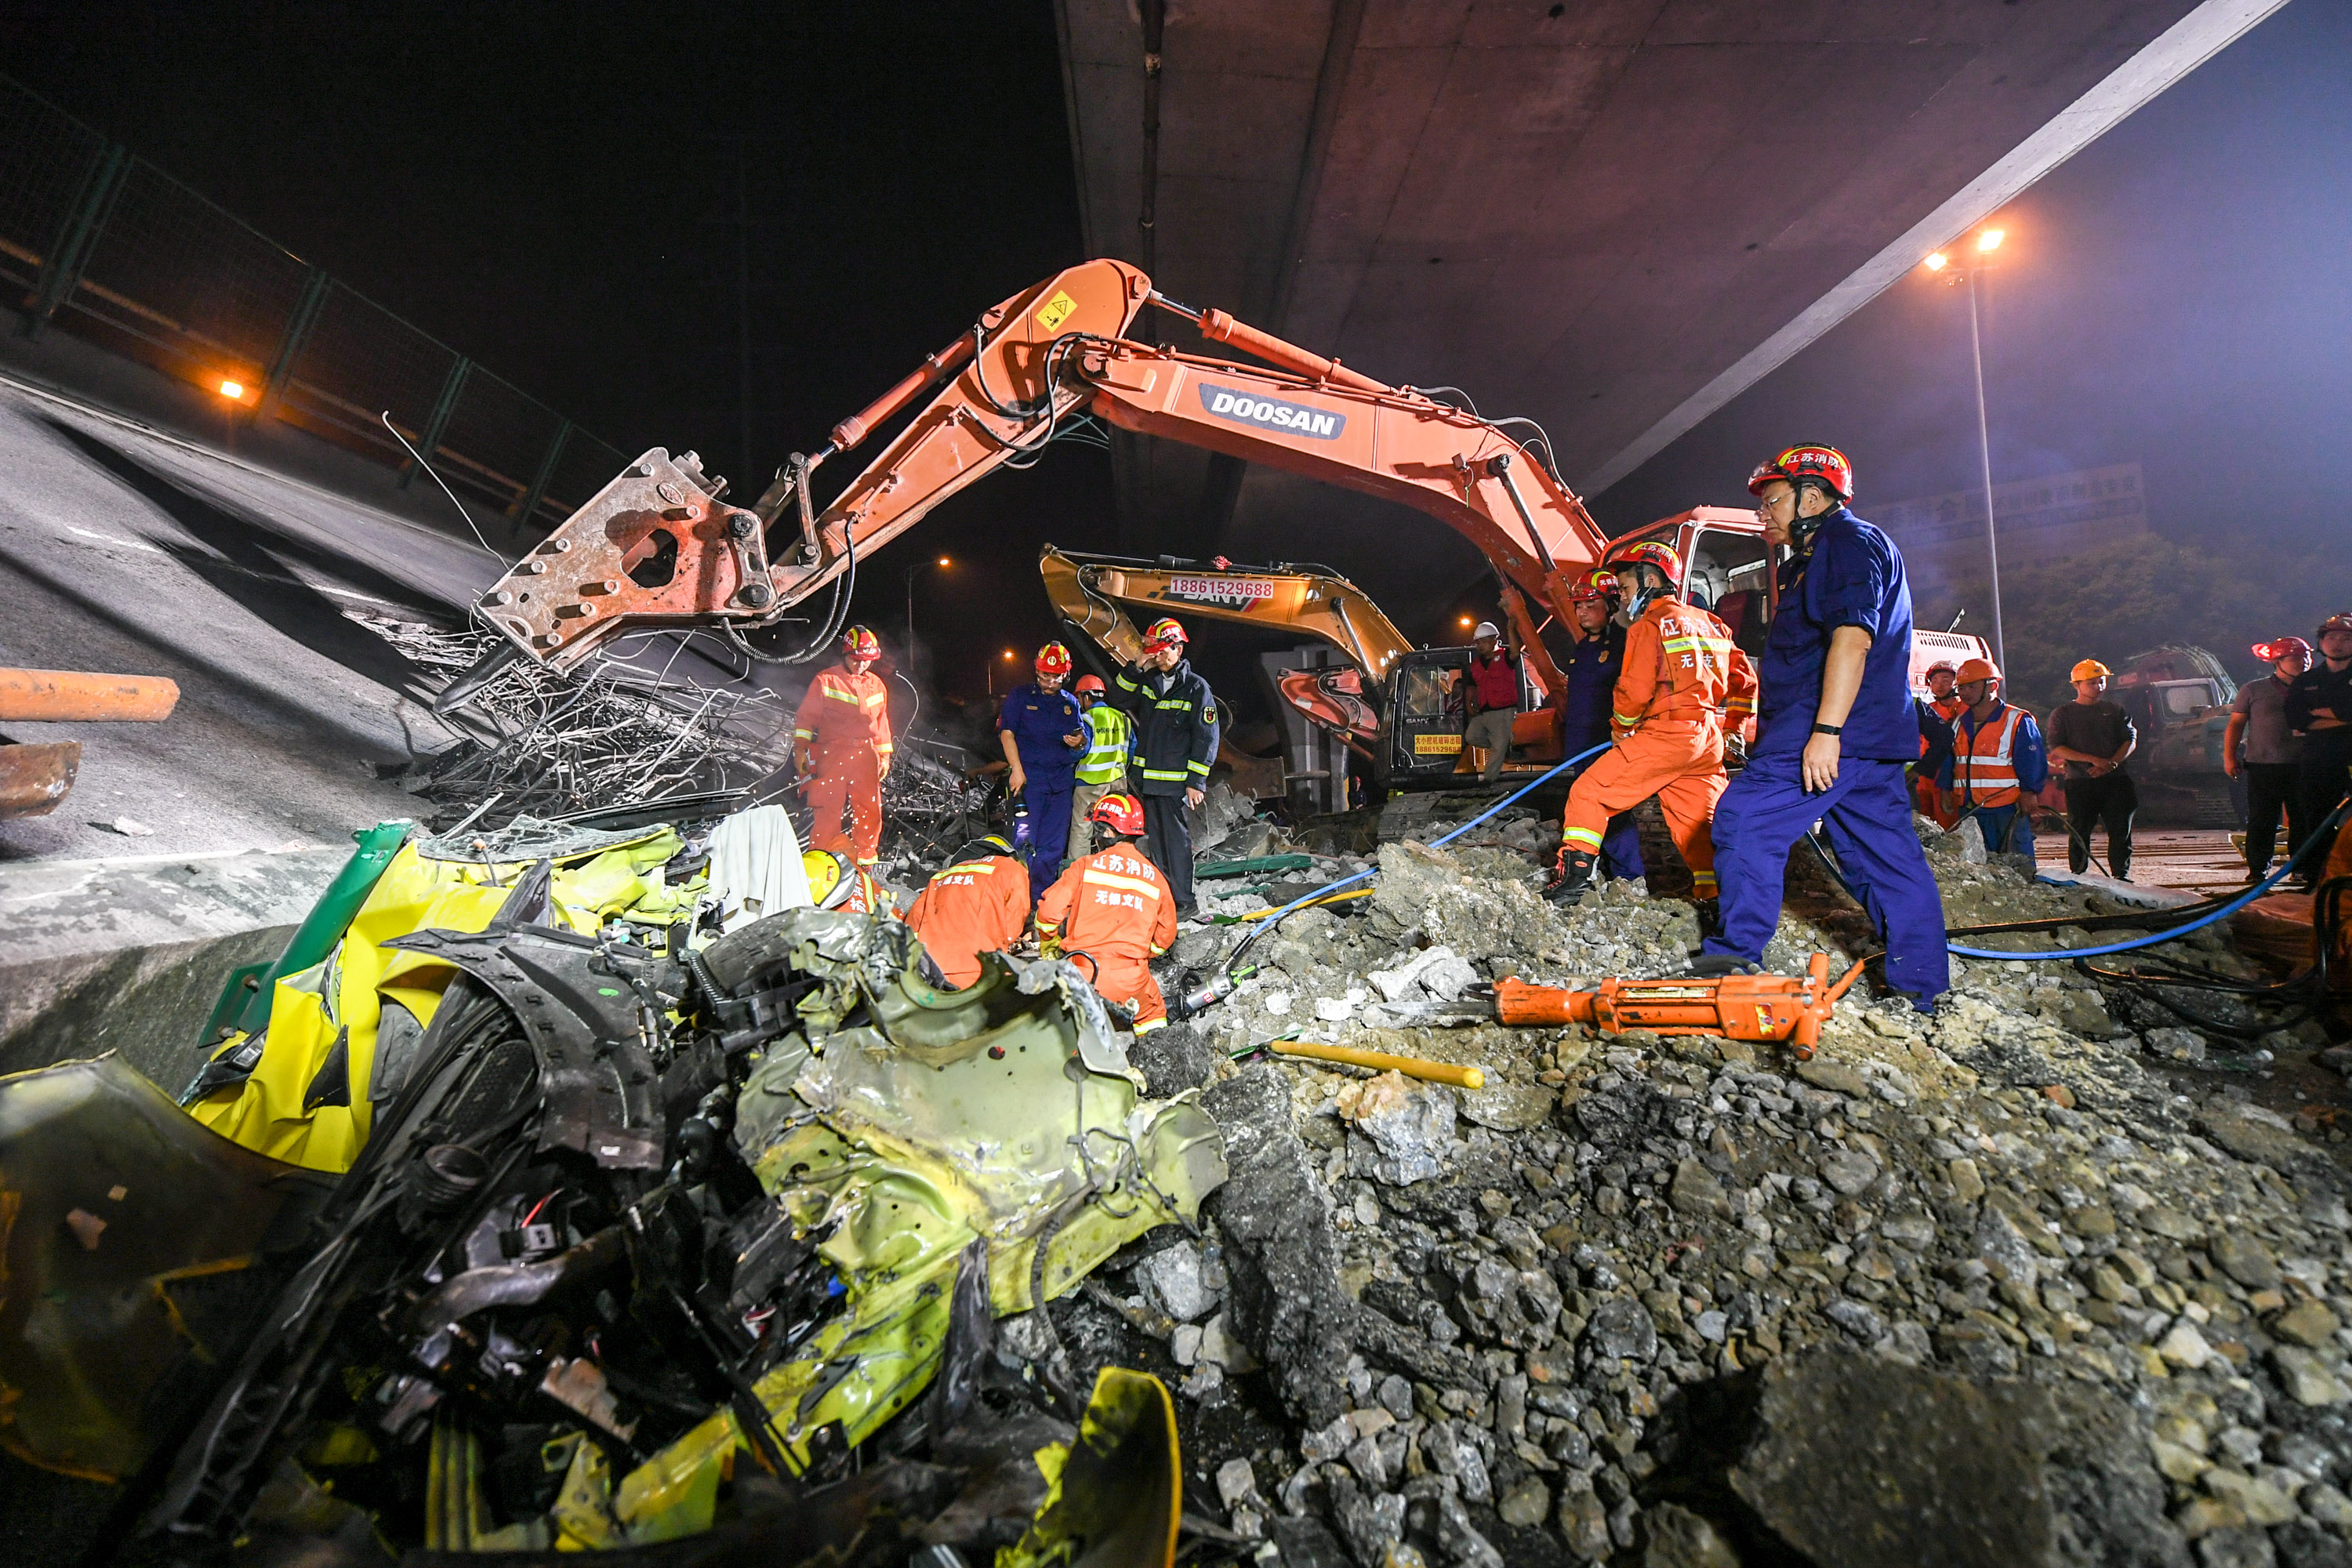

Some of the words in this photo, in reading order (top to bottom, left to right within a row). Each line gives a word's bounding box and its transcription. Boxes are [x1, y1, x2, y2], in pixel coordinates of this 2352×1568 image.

[1211, 392, 1335, 436] DOOSAN
[1787, 452, 1839, 468] 江苏消防
[1172, 579, 1272, 597] 18861529688
[1680, 654, 1726, 669] 无支队
[1098, 802, 1123, 815] 江苏消防
[1092, 854, 1156, 881] 江苏消防
[1094, 890, 1144, 912] 无锡支队
